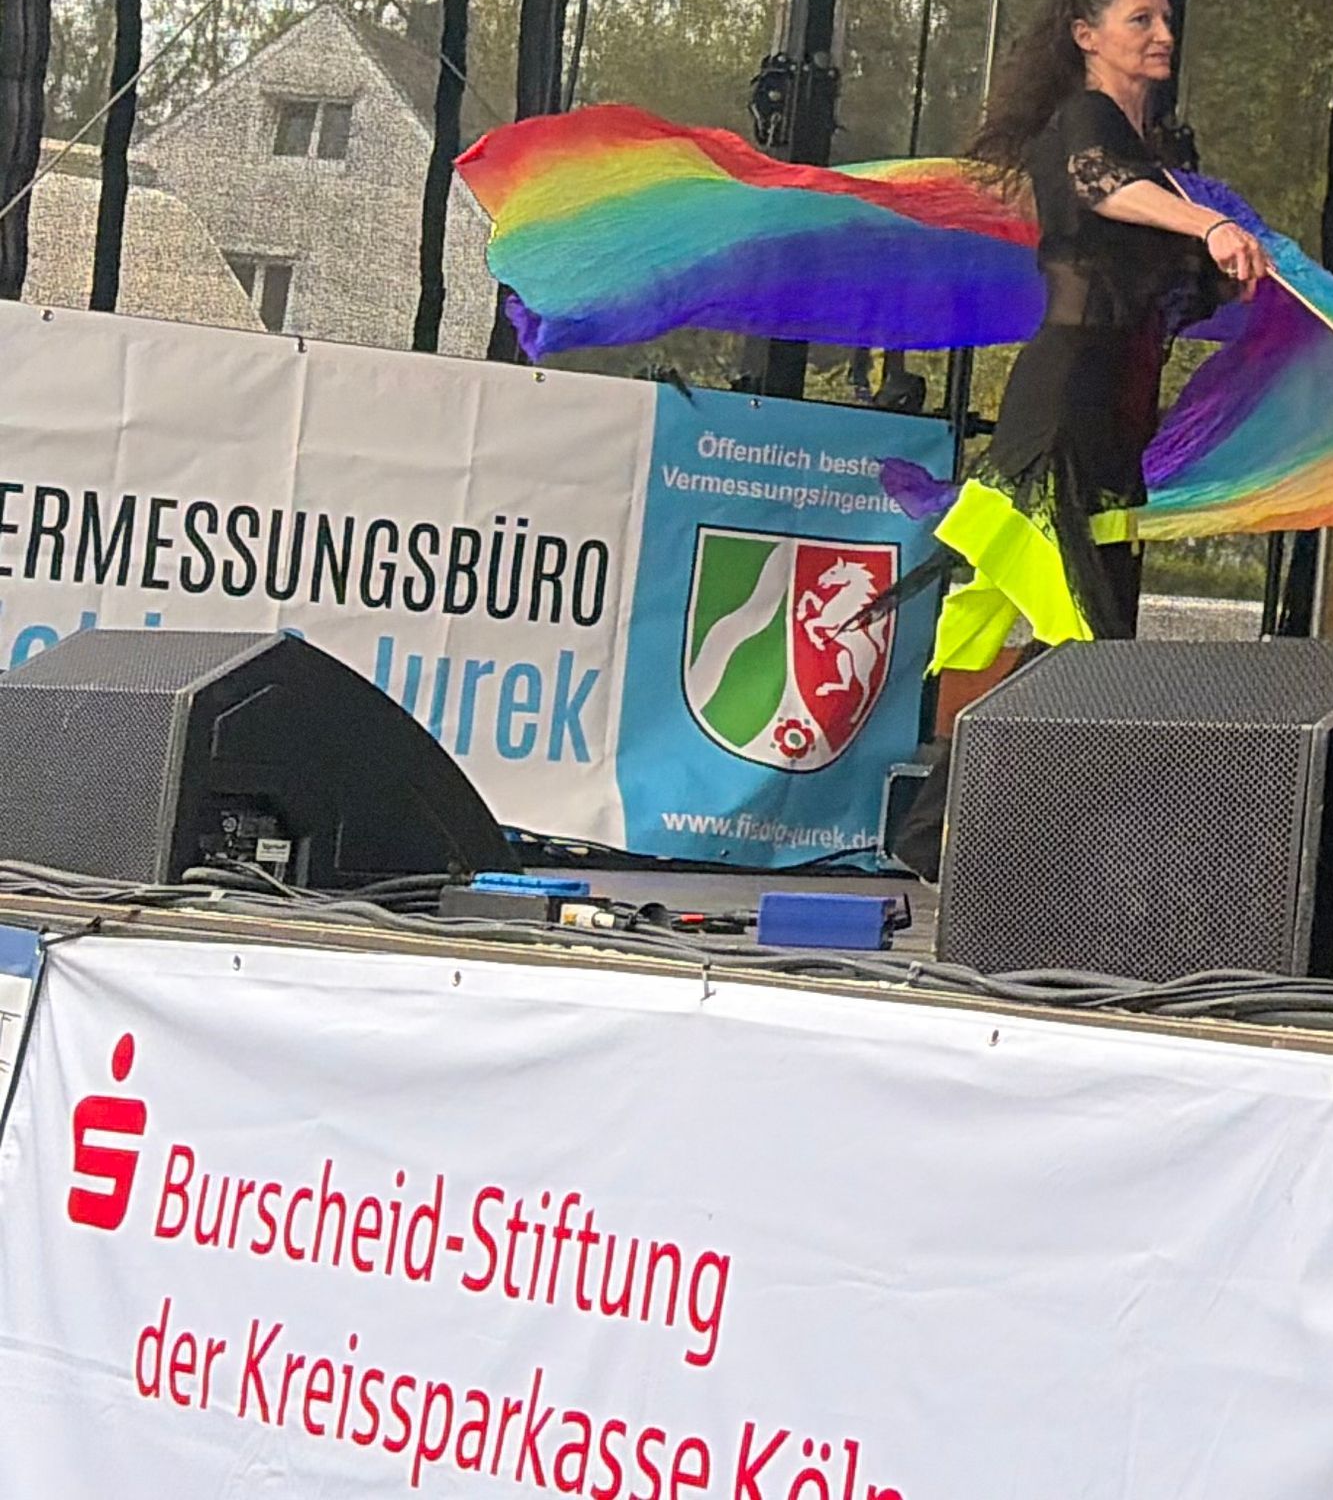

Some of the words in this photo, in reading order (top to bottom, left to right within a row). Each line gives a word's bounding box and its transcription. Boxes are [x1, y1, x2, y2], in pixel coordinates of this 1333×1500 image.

[697, 430, 811, 470] Öffentlich
[154, 1144, 732, 1367] Burscheid-Stiftung
[135, 1297, 226, 1407] der
[238, 1318, 712, 1500] Kreissparkasse
[735, 1420, 905, 1500] Köl
